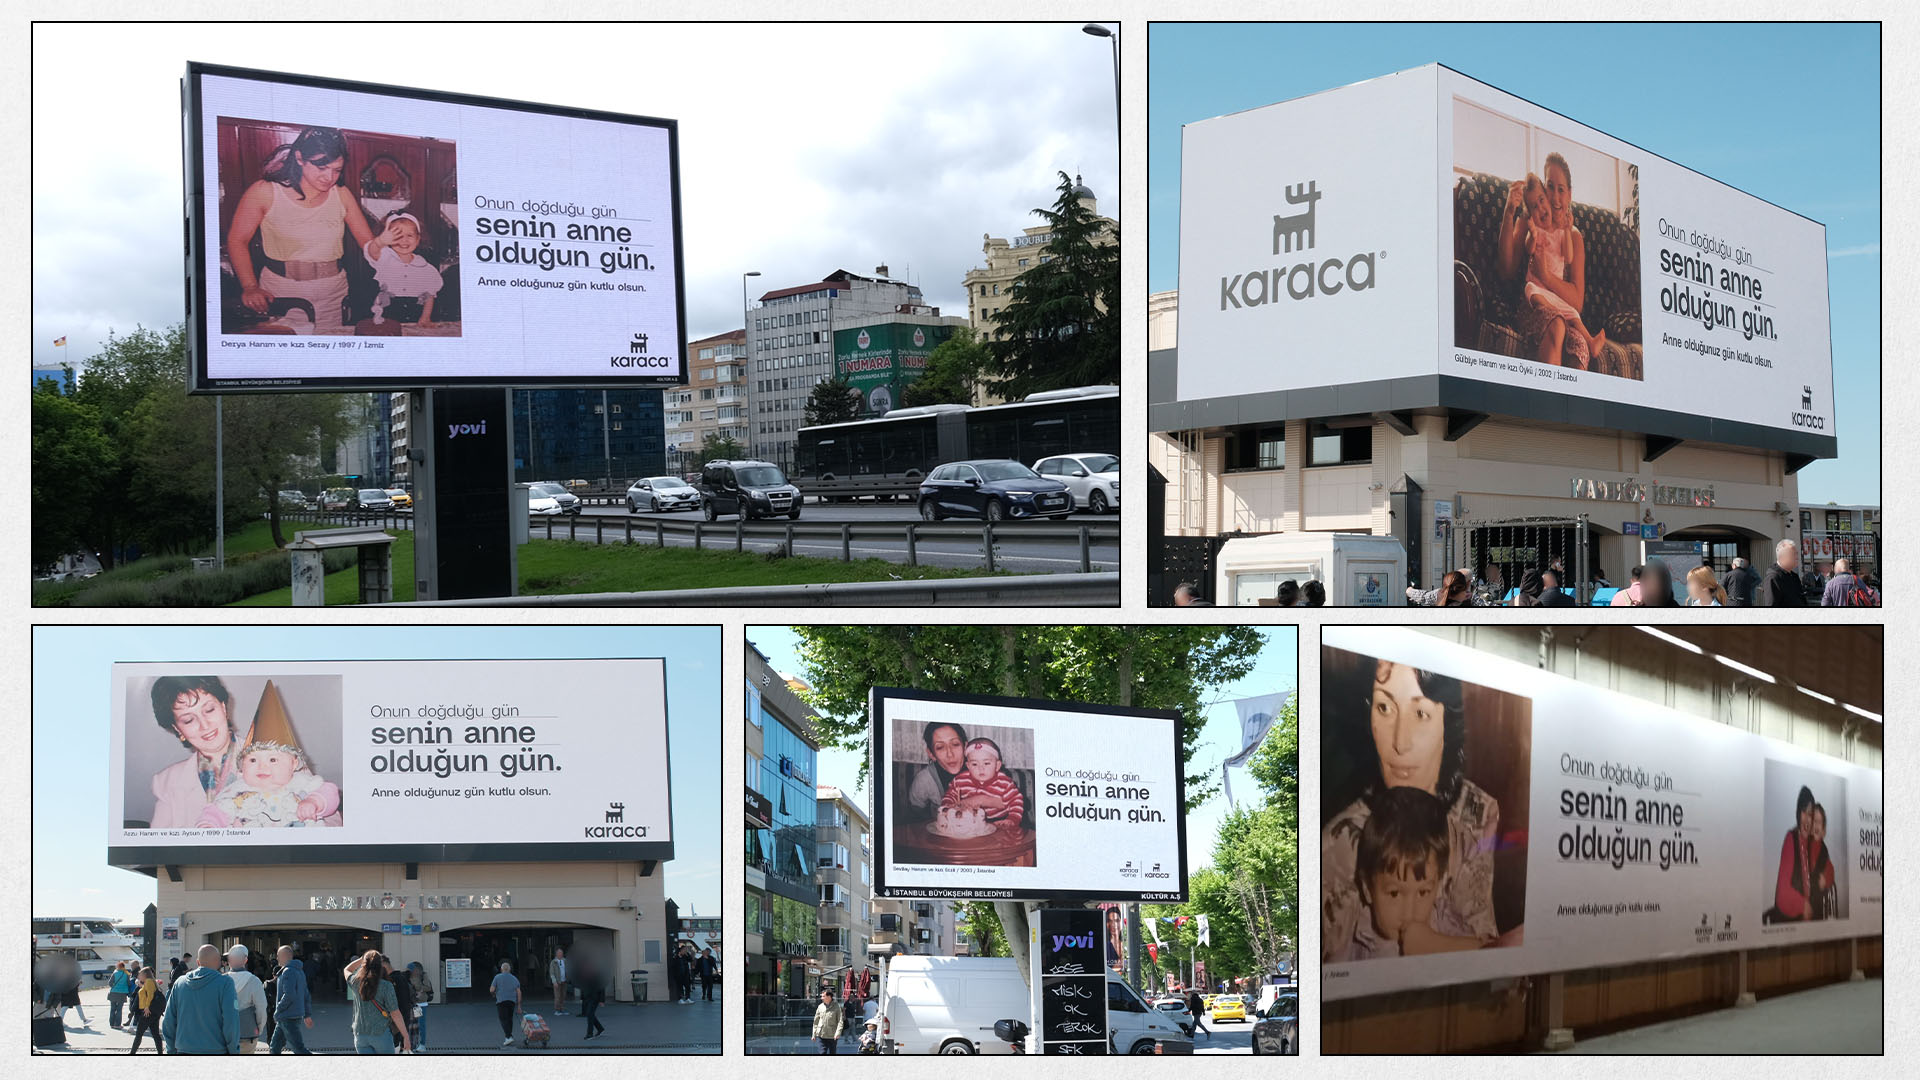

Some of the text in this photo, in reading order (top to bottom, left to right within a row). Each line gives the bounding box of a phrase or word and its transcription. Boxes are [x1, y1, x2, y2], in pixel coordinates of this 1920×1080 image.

[475, 196, 617, 218] Onun doğduğu gün
[476, 215, 632, 243] senin anne
[1659, 217, 1752, 266] Onun doğduğu gün
[476, 240, 655, 274] olduğun gün.
[478, 276, 647, 292] Anne olduğunuz gün kutlu olsun.
[1660, 248, 1762, 301] senin anne
[1660, 282, 1778, 341] olduğun gün.
[221, 340, 246, 349] Derya
[249, 340, 276, 348] Hanım
[308, 341, 330, 350] Seray
[364, 341, 385, 349] İzmir
[1662, 332, 1773, 368] Anne olduğunuz gün kutlu olsun.
[610, 356, 669, 368] karaca
[839, 356, 892, 374] 1 NUMARA
[1498, 362, 1506, 371] ve
[1538, 368, 1552, 378] 2002
[1557, 369, 1578, 383] İstanbul
[448, 419, 487, 439] yovi
[1791, 411, 1824, 430] karaca
[370, 704, 520, 720] Onun doğduğu gün
[371, 720, 536, 744] senin anne
[370, 747, 562, 779] olduğun gün.
[1560, 752, 1673, 792] Onun doğduğu gün
[1045, 767, 1140, 783] Onun doğduğu gün
[371, 786, 551, 799] Anne olduğunuz gün kutlu olsun.
[1046, 781, 1150, 800] senin anne
[1046, 801, 1166, 824] olduğun gün.
[1560, 786, 1684, 827] senin anne
[585, 826, 647, 838] karaca
[1558, 824, 1698, 871] olduğun gün.
[893, 889, 1014, 899] İSTANBUL BÜYÜKŞEHİR BELEDİYESİ
[1141, 892, 1169, 900] KÜLTÜR
[1557, 903, 1577, 917] Anne
[1614, 901, 1627, 916] gün
[1052, 930, 1094, 953] yovi
